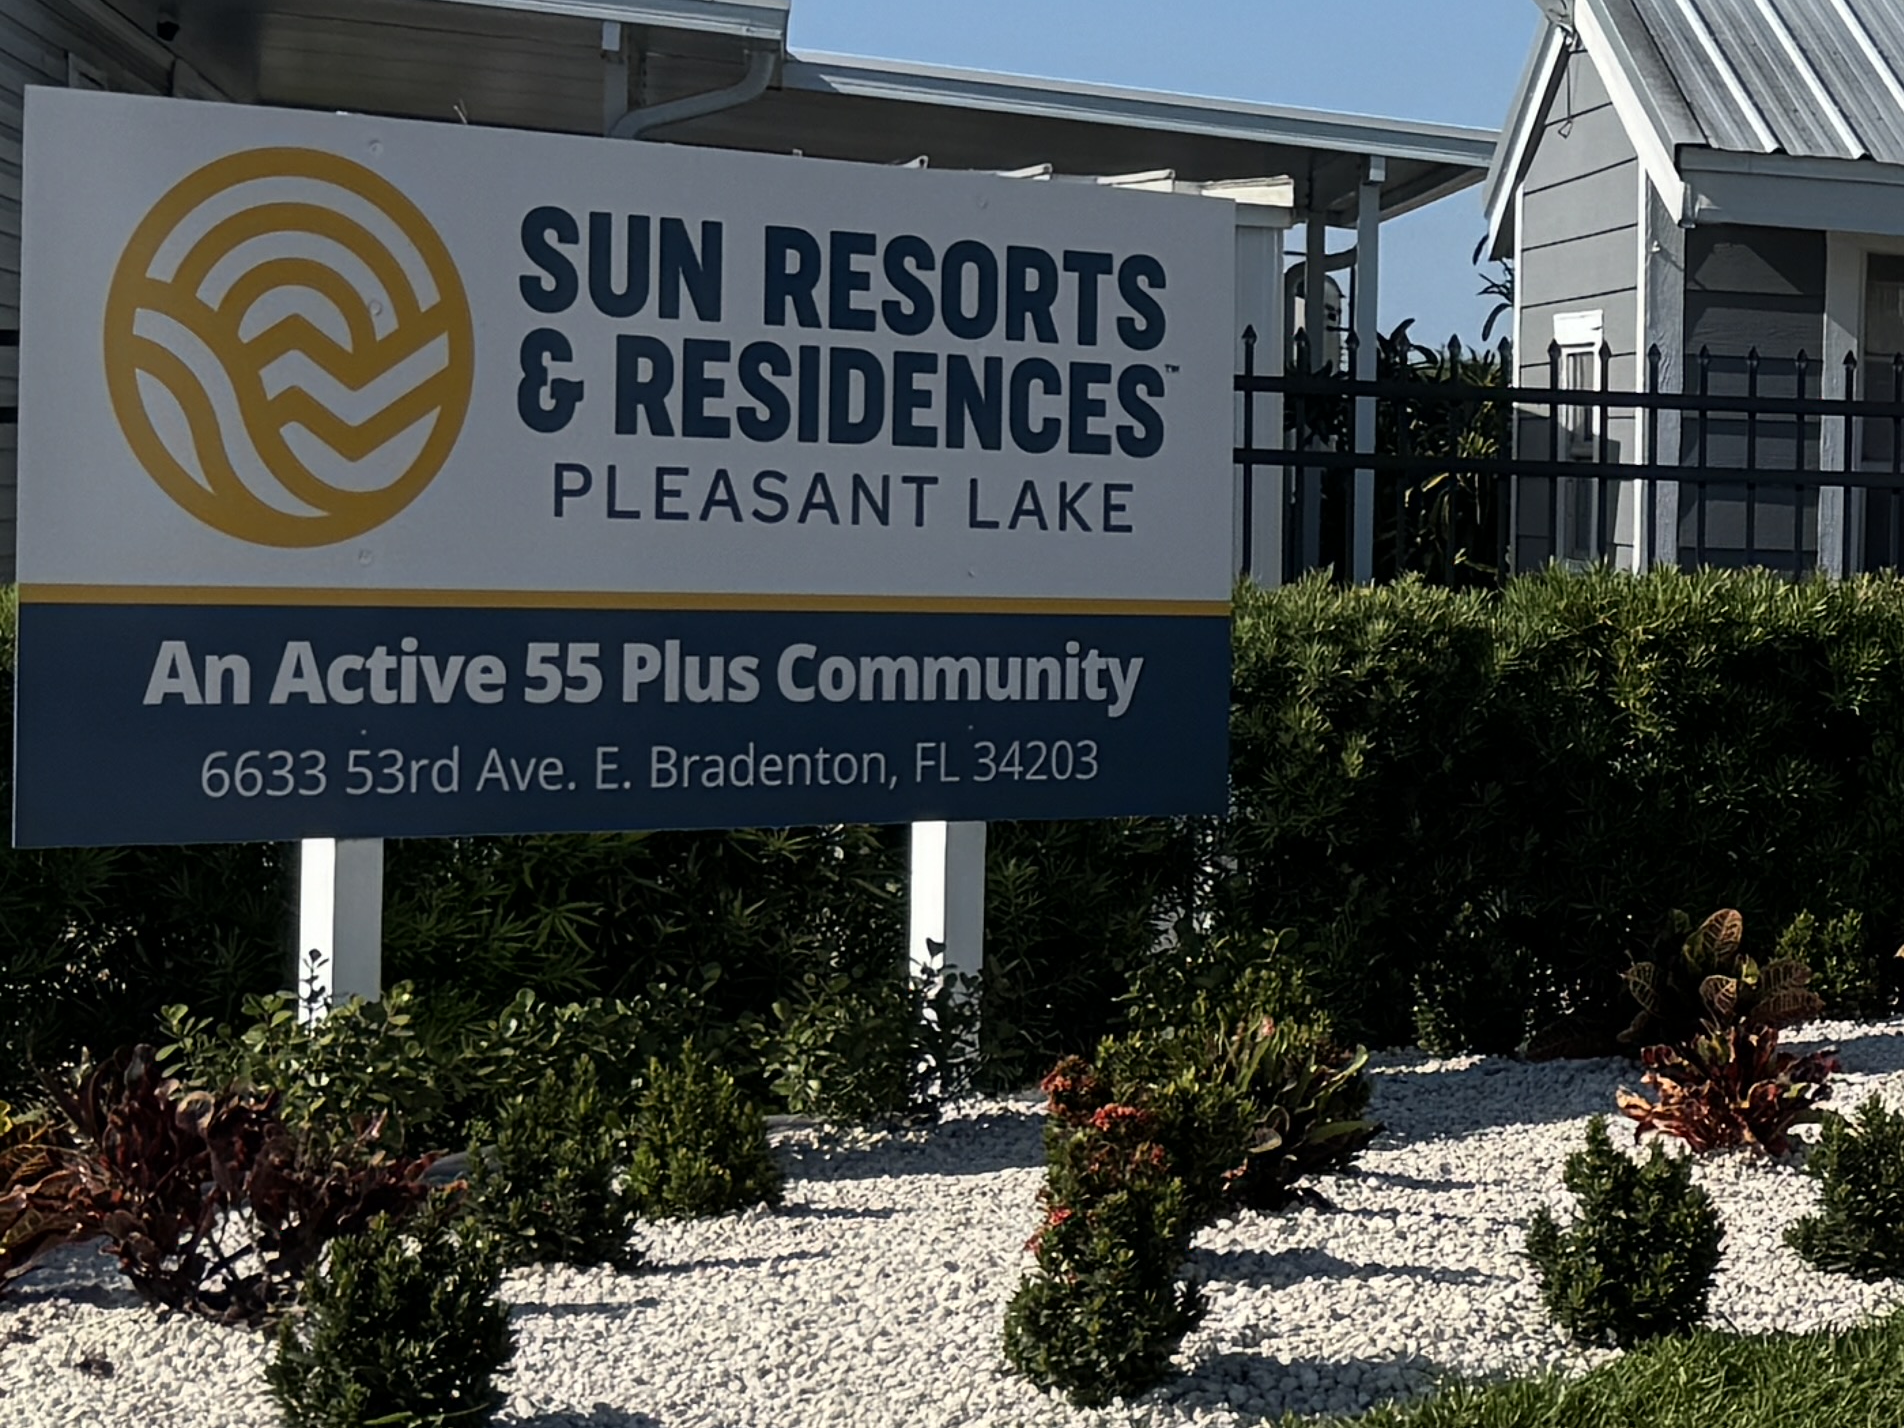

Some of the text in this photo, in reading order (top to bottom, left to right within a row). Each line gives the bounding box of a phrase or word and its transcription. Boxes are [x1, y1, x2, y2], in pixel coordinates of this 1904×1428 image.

[519, 206, 1167, 351] SUN RESORTS
[517, 328, 584, 433] &
[615, 333, 1165, 458] RESIDENCES
[553, 463, 1135, 533] PLEASANT LAKE
[143, 637, 1144, 718] An Active 55 Plus Community
[201, 740, 1099, 798] 6633 53rd Ave. E. Bradenton, FL 34203
